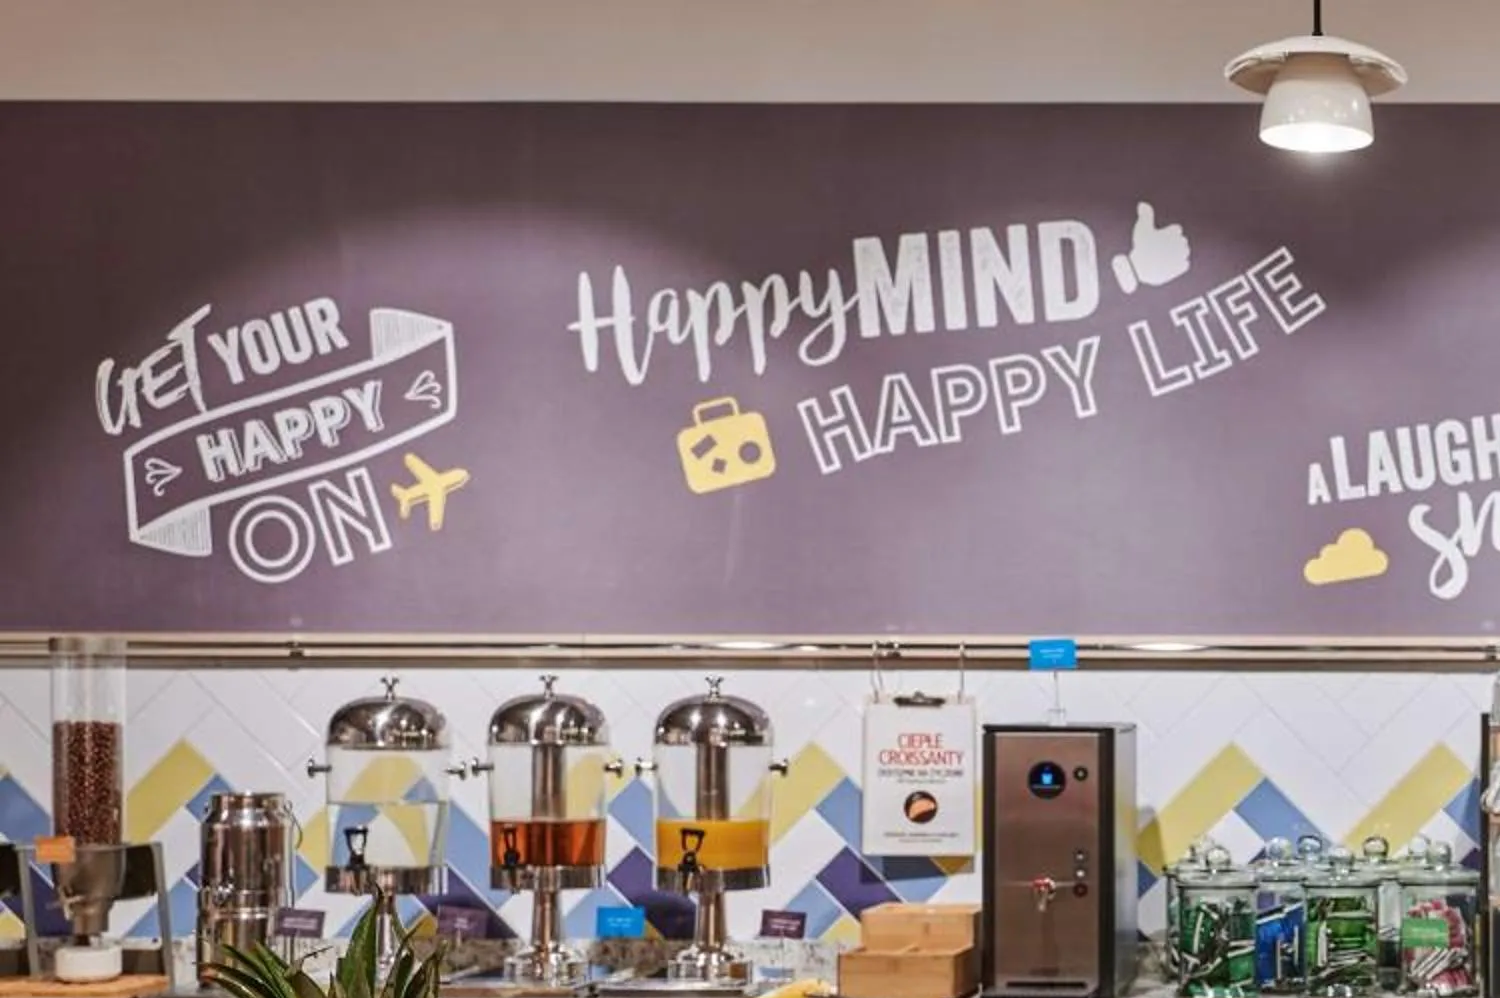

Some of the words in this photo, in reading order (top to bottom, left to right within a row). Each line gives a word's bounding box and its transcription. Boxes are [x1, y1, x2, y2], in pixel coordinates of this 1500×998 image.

[208, 297, 349, 384] YOUR
[567, 264, 860, 386] Happy
[853, 219, 1100, 337] MIND
[797, 336, 1101, 474] HAPPY
[1128, 246, 1327, 396] LIFE
[196, 380, 383, 483] HAPPY
[1308, 463, 1331, 505] A
[229, 467, 393, 583] ON
